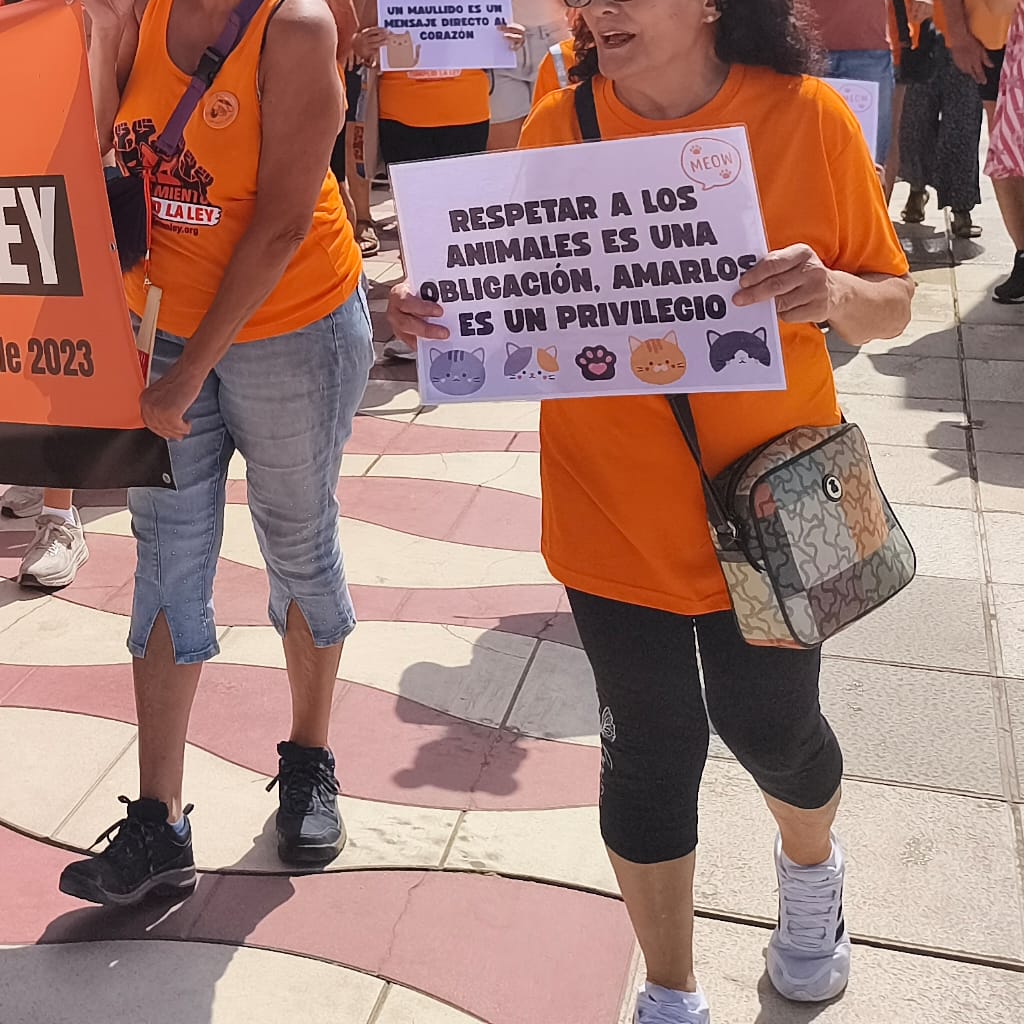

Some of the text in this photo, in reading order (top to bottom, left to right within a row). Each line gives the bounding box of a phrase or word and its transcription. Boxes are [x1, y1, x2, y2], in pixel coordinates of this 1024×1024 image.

[384, 18, 437, 28] MENSAJE
[441, 17, 489, 26] DIRECTO
[387, 4, 502, 15] UN MAULLIDO ES UN
[419, 28, 474, 40] CORAZÓN
[690, 152, 733, 173] MEOW
[165, 203, 184, 219] LA
[187, 206, 214, 223] LEY
[448, 185, 698, 233] RESPETAR A LOS
[446, 221, 718, 268] ANIMALES ES UNA
[420, 262, 601, 303] OBLIGACIÓN,
[458, 294, 727, 337] ES UN PRIVILEGIO
[27, 337, 95, 378] 2023
